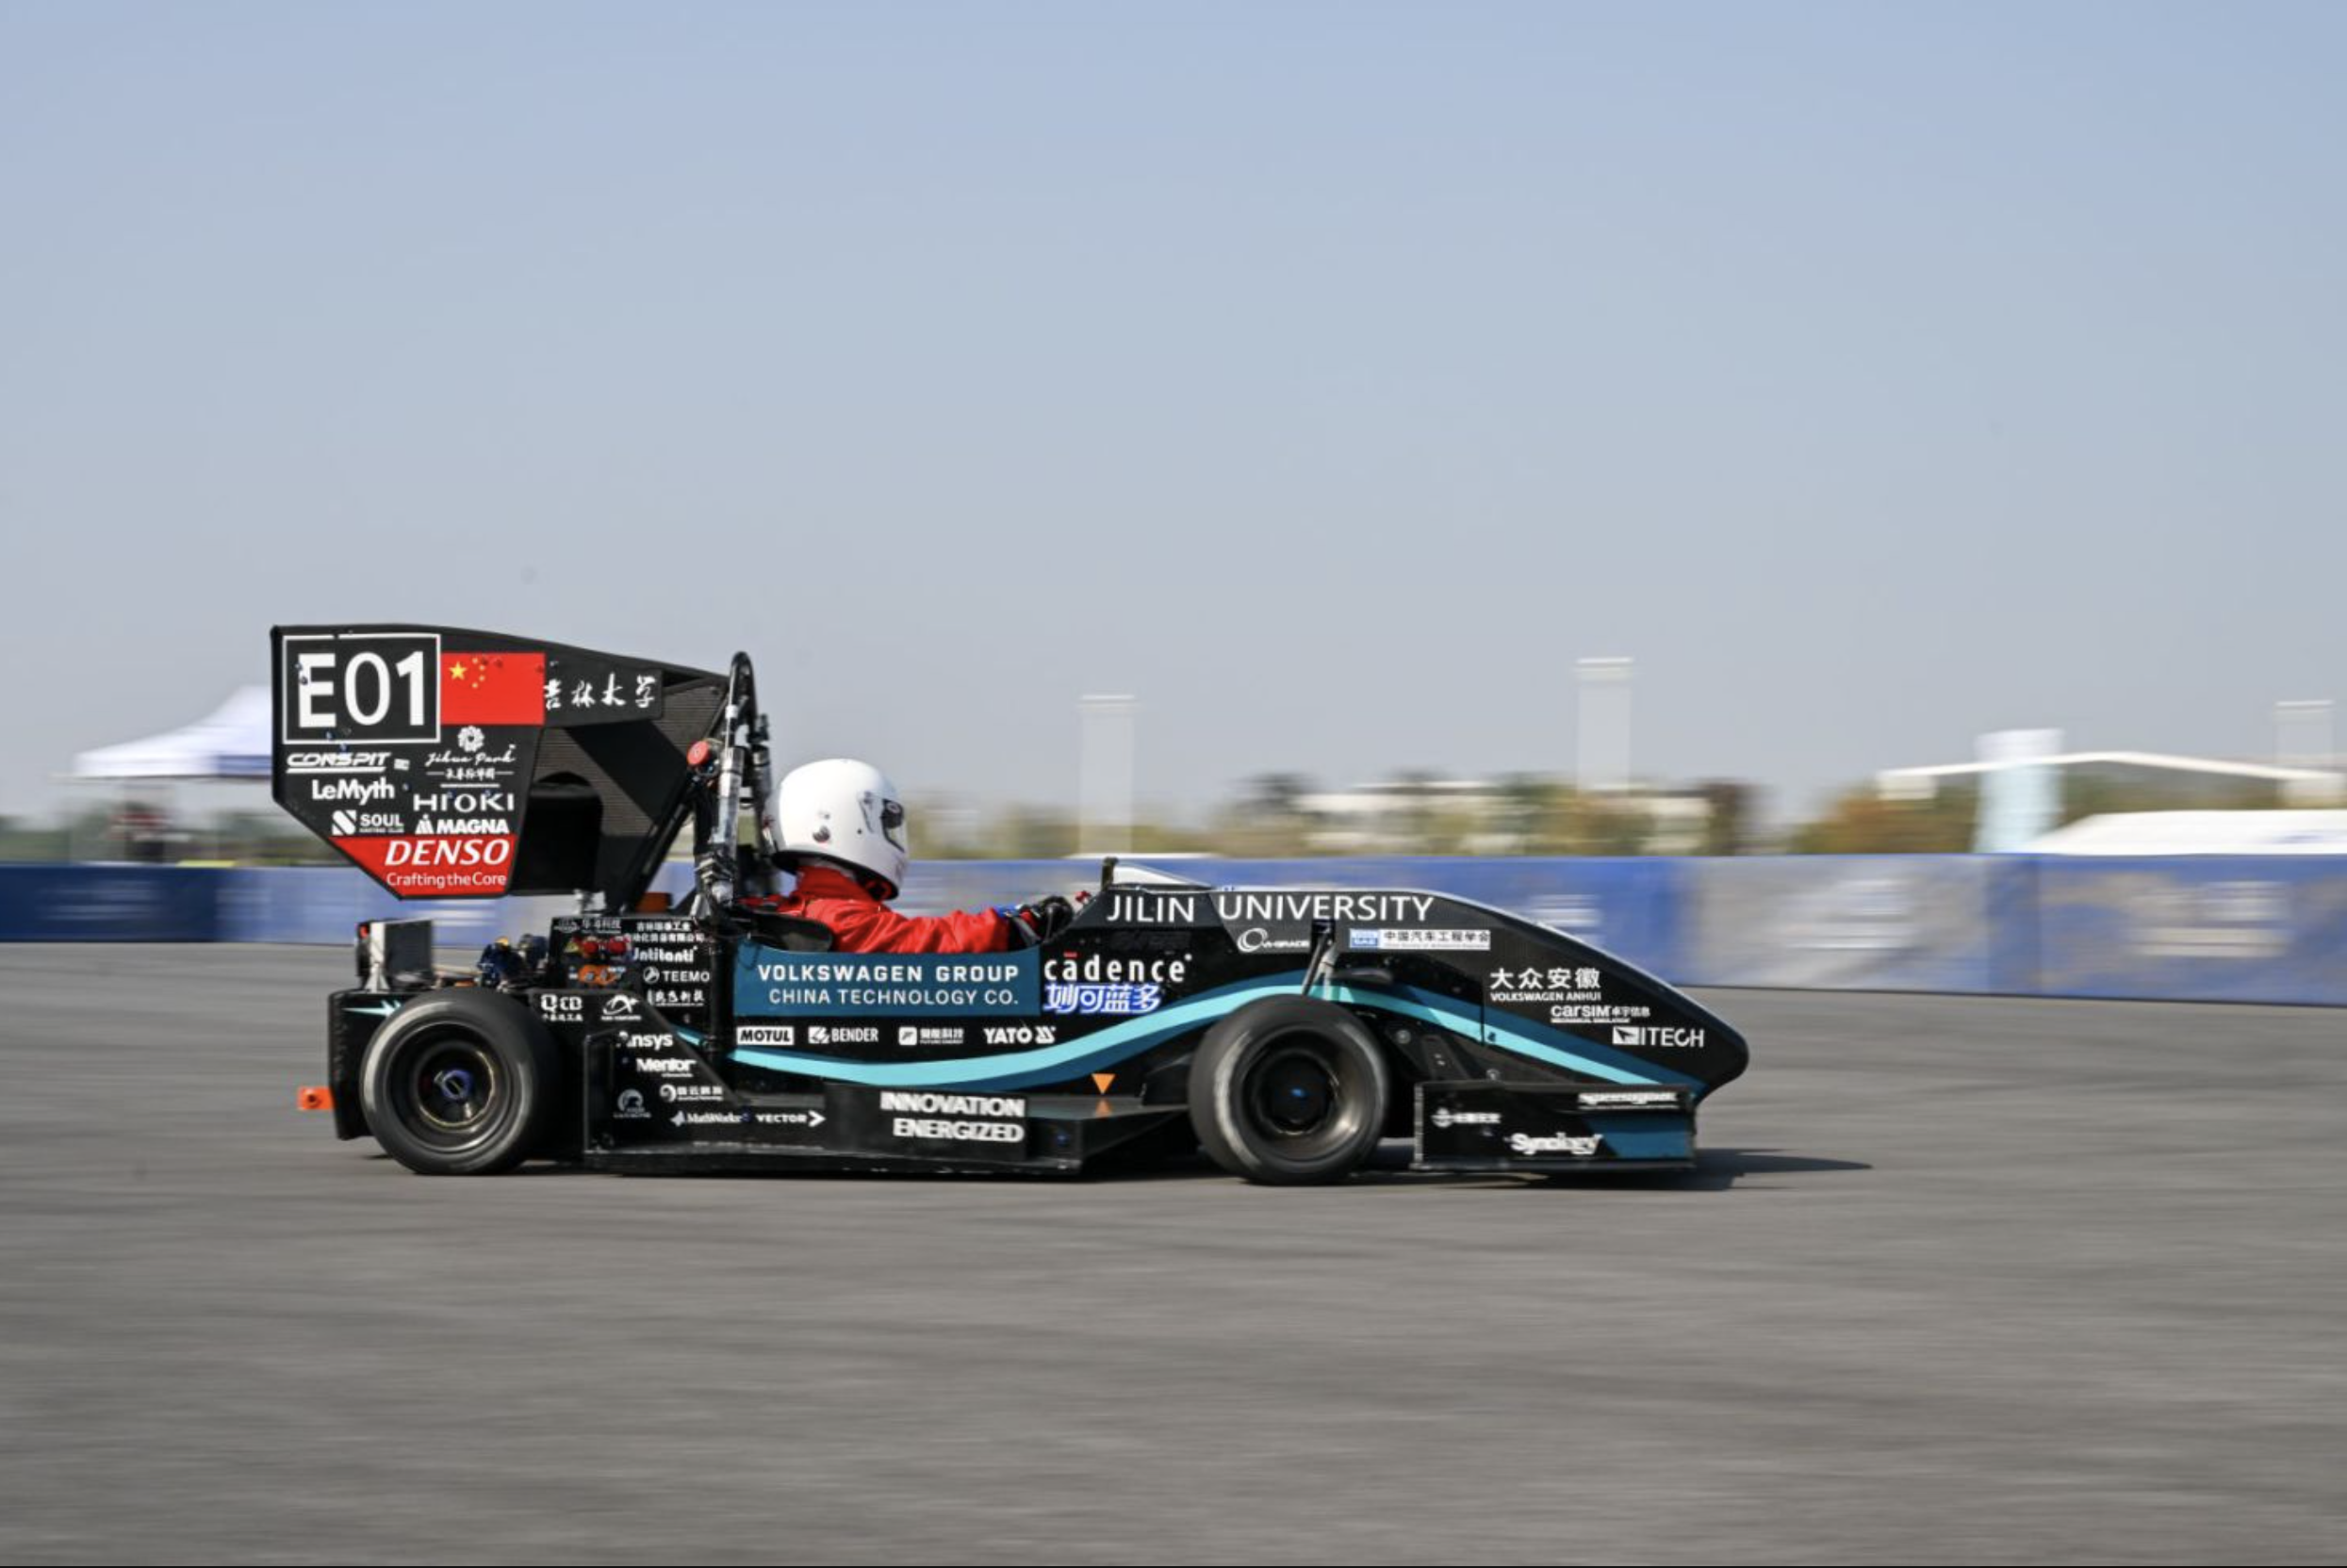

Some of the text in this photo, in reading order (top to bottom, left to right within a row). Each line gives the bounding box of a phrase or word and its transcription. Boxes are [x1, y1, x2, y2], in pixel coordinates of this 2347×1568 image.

[298, 651, 424, 727] E01
[543, 673, 658, 710] 吉林大学
[287, 752, 391, 767] CONSPIT
[312, 776, 395, 806] LeMyth
[413, 793, 514, 813] HIOKI
[360, 813, 404, 826] SOUL
[436, 819, 510, 834] MAGNA
[384, 839, 510, 865] DENSO
[386, 872, 507, 889] Crafting the Core
[1107, 895, 1435, 923] JILIN UNIVERSITY
[1384, 931, 1489, 942] 中国汽车工程学会
[663, 971, 710, 982] TEEMO
[758, 965, 1019, 982] VOLKSWAGEN GROUP
[1490, 968, 1601, 988] 大众安徽
[769, 989, 1019, 1004] CHINA TECHNOLOGY CO.
[1042, 982, 1161, 1014] 妙可蓝多
[1490, 992, 1601, 1002] VOLKSWAGEN ANHUI
[740, 1029, 791, 1042] MOTUL
[831, 1028, 878, 1043] BENDER
[984, 1027, 1033, 1043] YATO
[1641, 1027, 1705, 1048] ITECH
[635, 1058, 698, 1072] Mentor
[880, 1092, 1026, 1117] INNOVATION
[756, 1115, 807, 1123] VECTOR
[894, 1118, 1025, 1142] ENERGIZED
